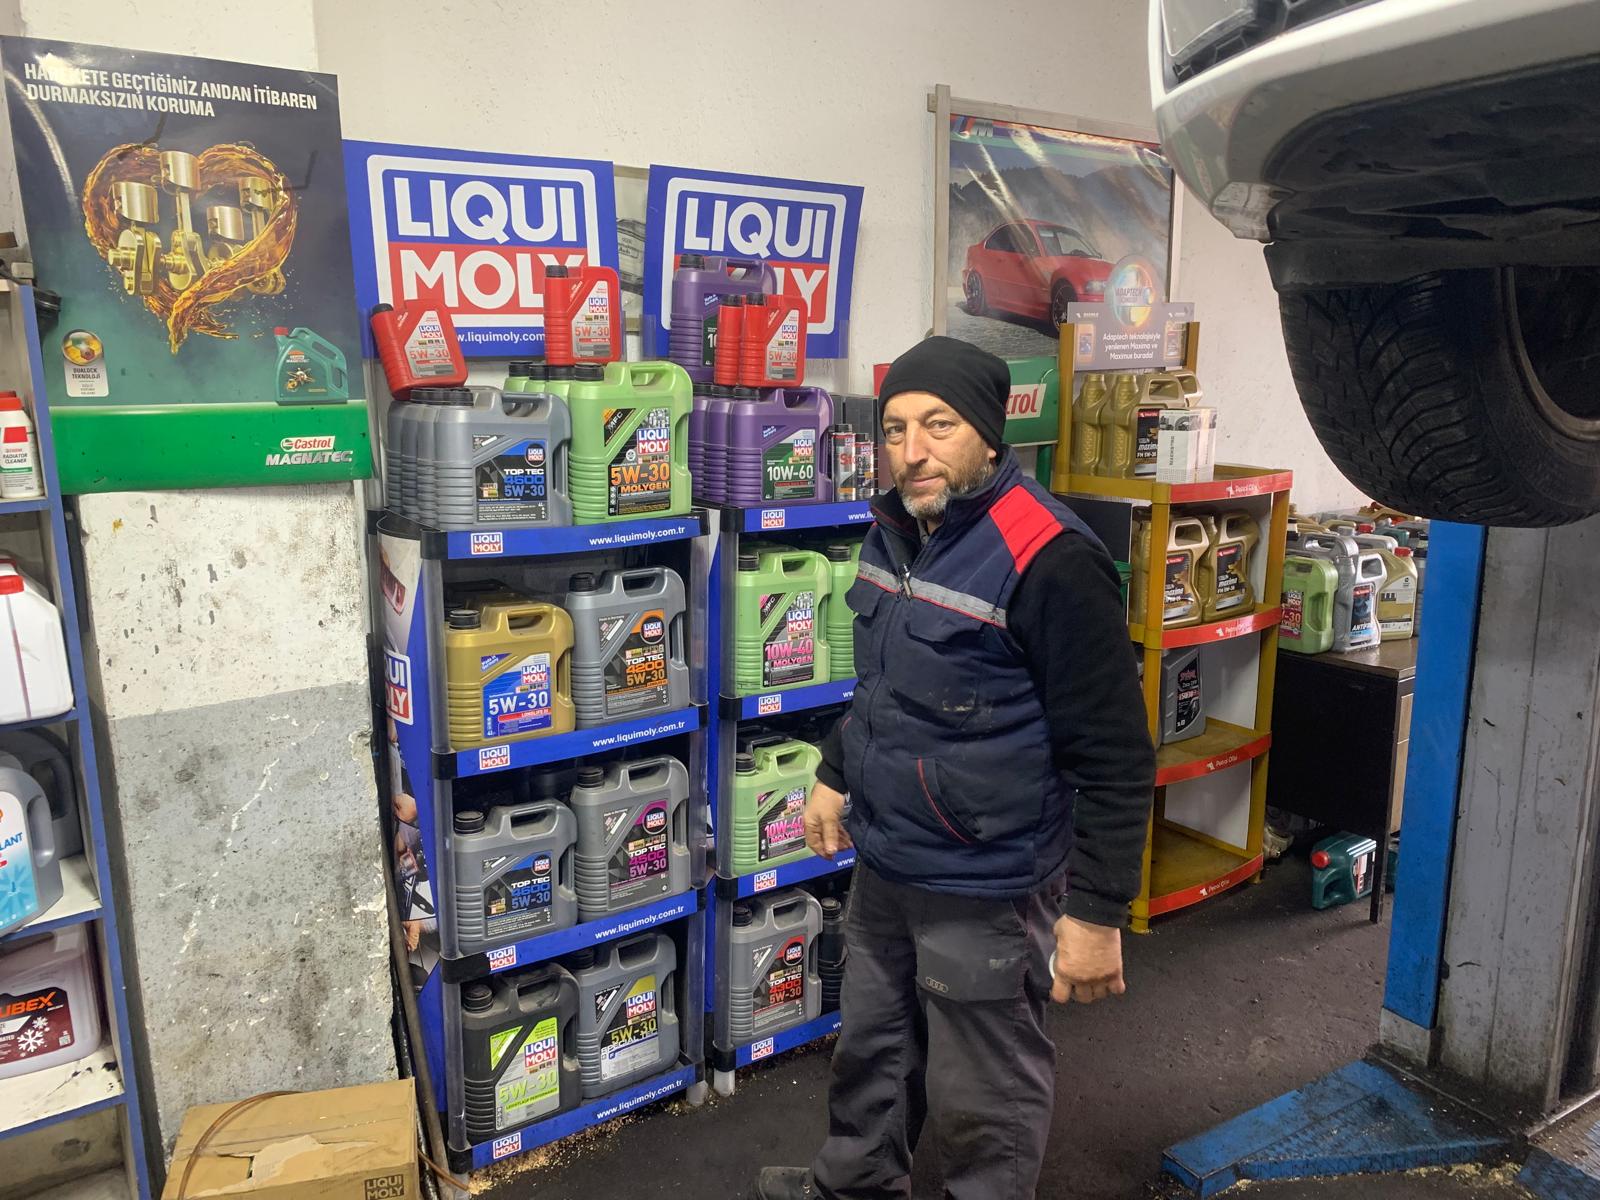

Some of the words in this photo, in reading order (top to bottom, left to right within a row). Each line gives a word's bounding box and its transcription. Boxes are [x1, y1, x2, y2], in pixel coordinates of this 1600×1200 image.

[24, 63, 109, 87] HAETE
[112, 72, 198, 97] GEÇTİĞİNİZ
[201, 82, 251, 102] ANDAN
[254, 85, 317, 110] İTİBAREN
[27, 84, 144, 109] DURMAKSIZIN
[146, 96, 215, 117] KORUMA
[394, 177, 577, 244] LIQUI
[684, 198, 828, 259] LIQUI
[575, 327, 609, 337] 5W-30
[1103, 333, 1129, 342] Adaptech
[1105, 343, 1130, 352] yenilenen
[1110, 352, 1133, 360] Maximus
[638, 429, 667, 440] LIQUI
[294, 438, 332, 450] Castrol
[639, 441, 668, 453] MOLY
[794, 448, 813, 456] MOLY
[265, 451, 353, 466] MAGNATEC
[611, 463, 669, 485] 5W-30
[767, 465, 814, 481] 10W-60
[504, 485, 545, 497] 5W-30
[620, 482, 669, 493] MOLYGEN
[763, 511, 783, 519] LIQUI
[763, 519, 784, 528] MOLY
[474, 534, 500, 543] LIQUI
[589, 526, 686, 546] www.liquimoly.com.tr
[474, 543, 501, 552] MOLY
[788, 609, 811, 621] LIQUI
[644, 622, 661, 630] LIQUI
[788, 620, 812, 631] MOLY
[644, 629, 662, 637] MOLY
[765, 639, 813, 660] 10W-40
[626, 657, 644, 665] TOP
[646, 654, 664, 662] TEC
[773, 655, 813, 667] MOLYGEN
[522, 664, 546, 674] LIQUI
[626, 660, 664, 673] 4200
[523, 673, 547, 683] MOLY
[627, 669, 664, 686] 5W-30
[489, 692, 548, 715] 5W-30
[760, 696, 779, 704] LIQUI
[760, 704, 780, 713] MOLY
[593, 720, 685, 747] www.liquimoly.com.tr
[482, 746, 507, 757] LIQUI
[482, 756, 508, 768] MOLY
[788, 792, 804, 801] LIQUI
[788, 799, 804, 808] MOLY
[647, 812, 664, 820] LIQUI
[647, 818, 665, 827] MOLY
[629, 848, 648, 857] TOP
[649, 843, 666, 851] TEC
[629, 850, 666, 865] 4500
[630, 858, 666, 878] 5W-30
[511, 880, 530, 888] TOP
[532, 876, 550, 884] TEC
[756, 872, 775, 882] LIQUI
[756, 879, 775, 890] MOLY
[512, 891, 550, 909] 5W-30
[595, 904, 685, 939] www.liquimoly.com.tr
[489, 949, 514, 962] LIQUI
[490, 956, 515, 970] MOLY
[769, 980, 801, 994] 4300
[770, 977, 785, 986] TOP
[628, 992, 653, 1007] LIQUI
[770, 987, 802, 1003] 5W-30
[628, 1001, 655, 1017] MOLY
[611, 1018, 657, 1042] 5W-30
[525, 1038, 554, 1055] LIQUI
[753, 1040, 772, 1051] LIQUI
[526, 1048, 555, 1067] MOLY
[753, 1046, 772, 1058] MOLY
[500, 1071, 557, 1104] 5W-30
[597, 1079, 683, 1120] www.liquimoly.com.tr
[495, 1135, 518, 1149] LIQUI
[496, 1142, 519, 1157] MOLY
[366, 1176, 402, 1189] LIQUI
[367, 1186, 403, 1200] MOLY
